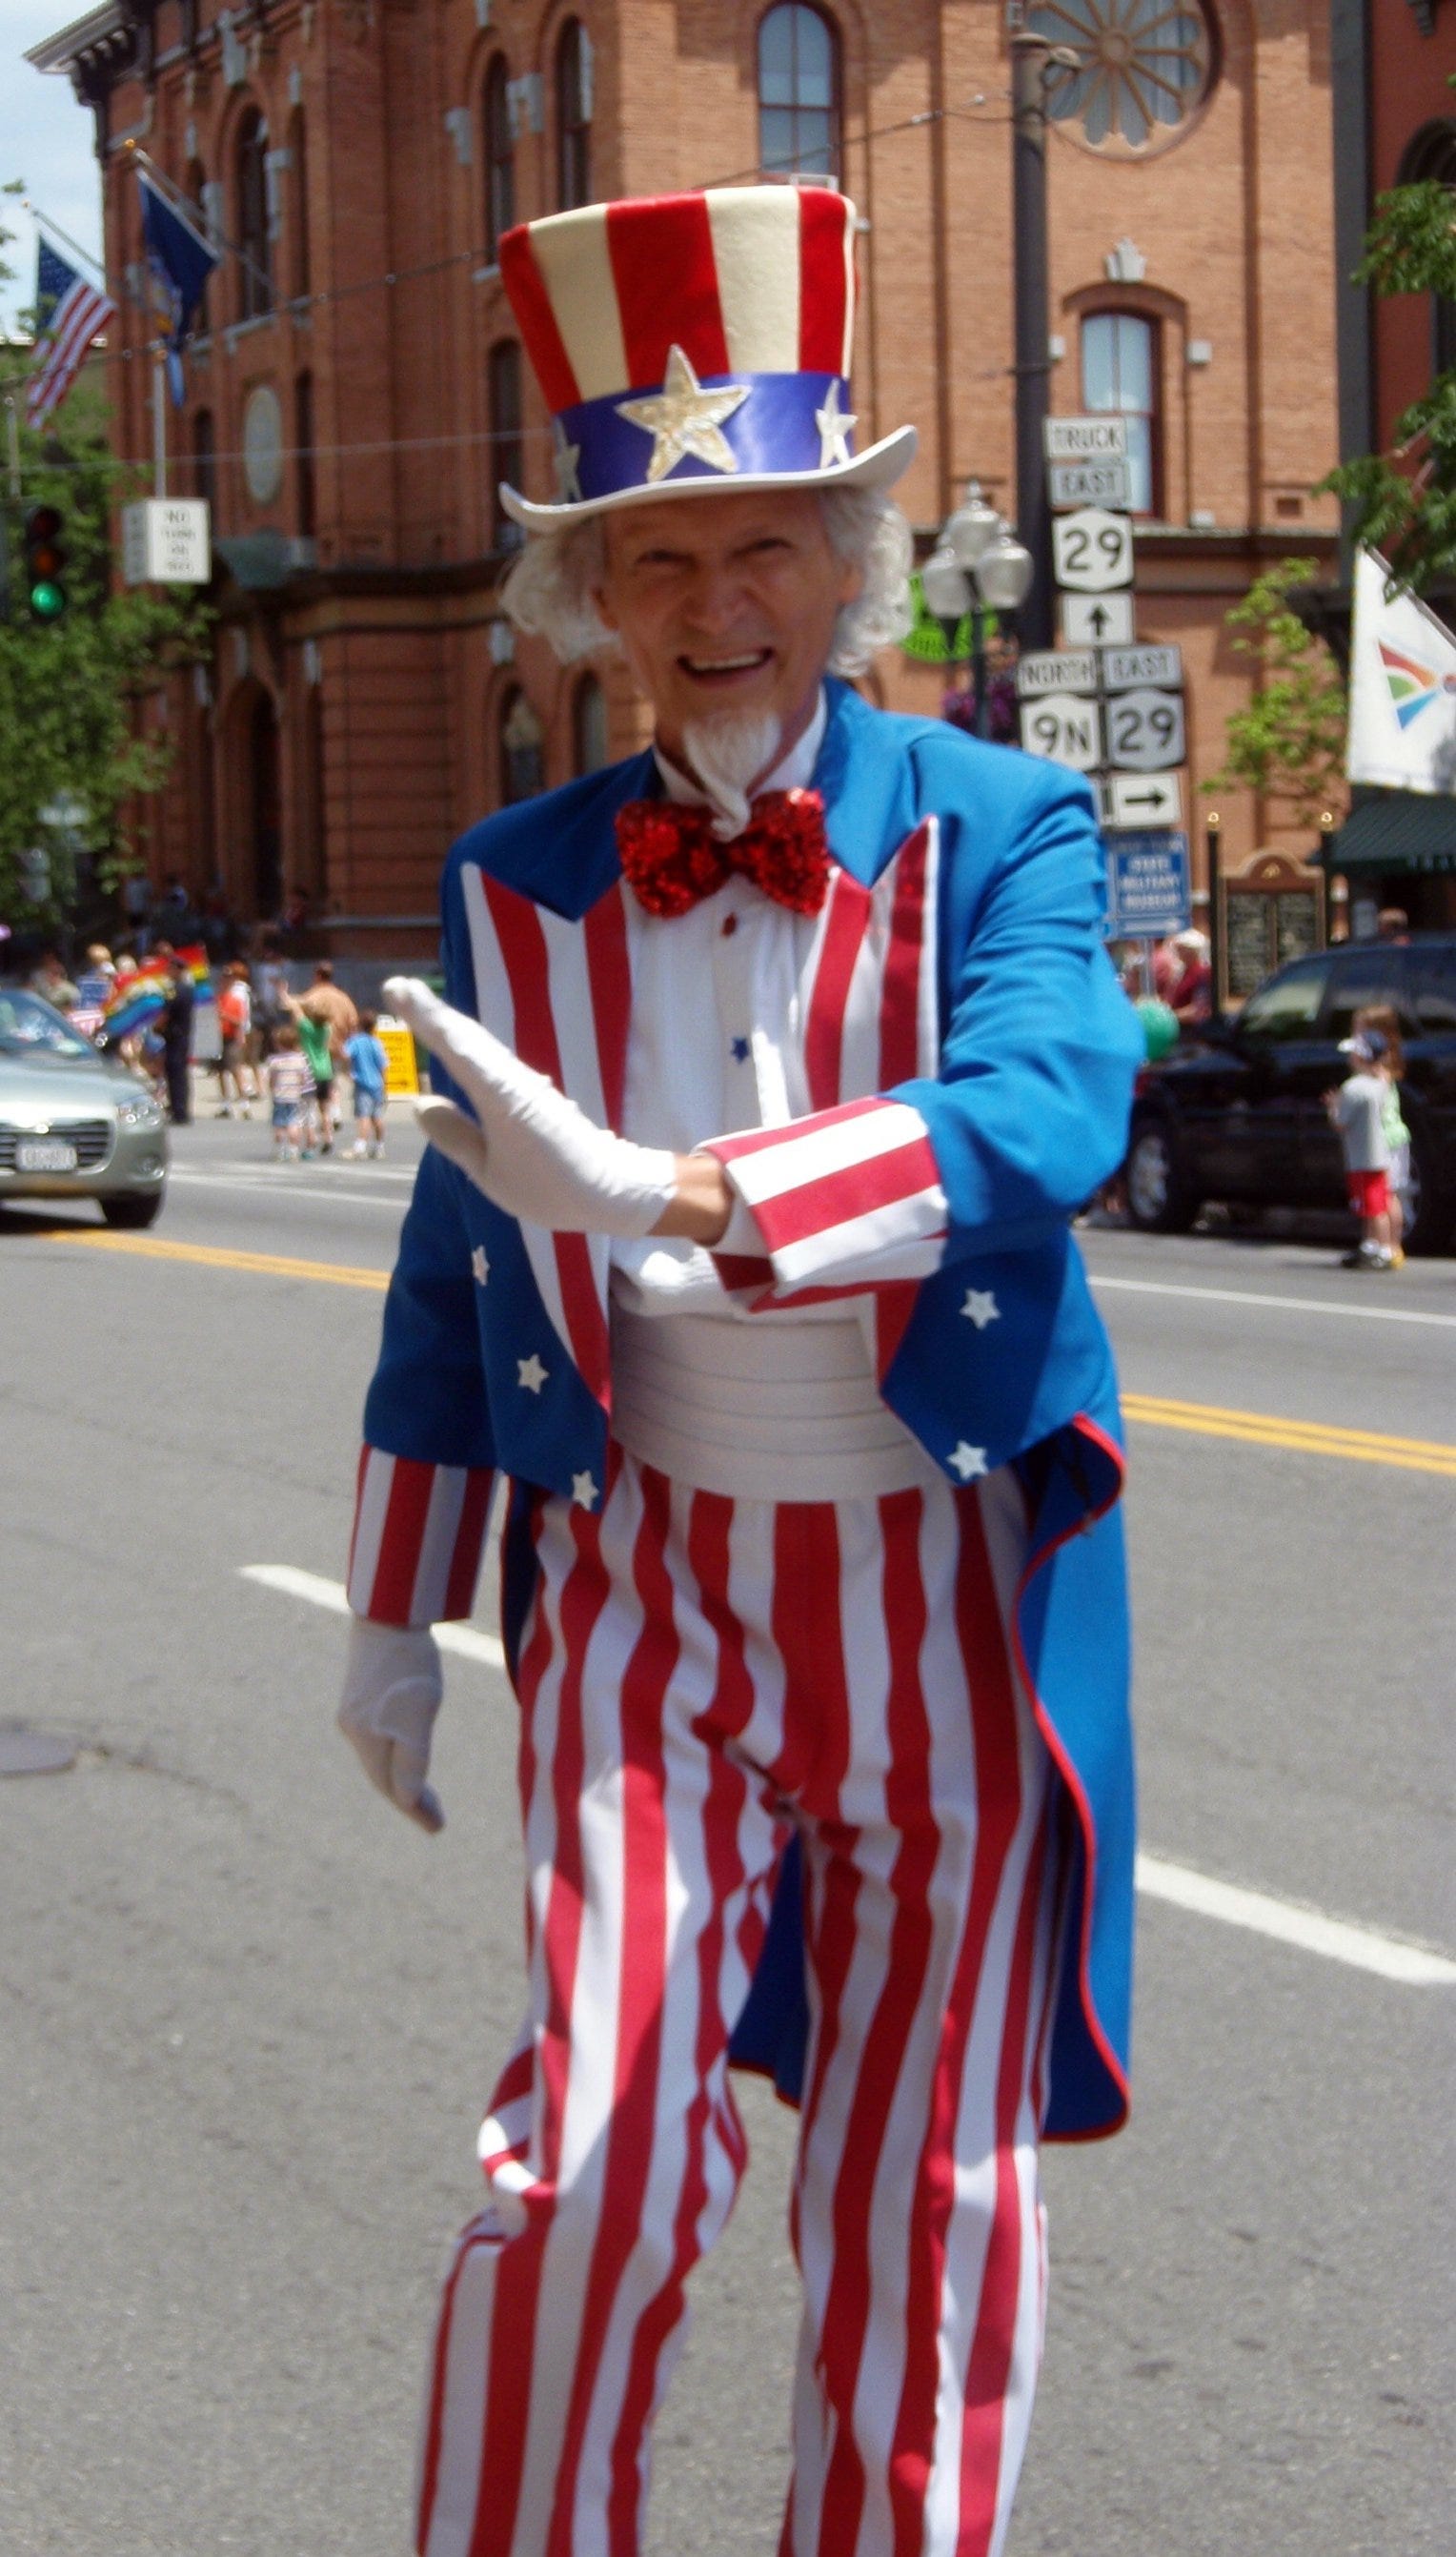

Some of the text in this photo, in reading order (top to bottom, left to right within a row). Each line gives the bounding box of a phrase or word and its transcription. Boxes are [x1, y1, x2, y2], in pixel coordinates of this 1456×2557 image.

[1054, 425, 1122, 449] TRUCK
[1062, 470, 1116, 493] EAST
[1064, 530, 1123, 570] 29
[1026, 658, 1095, 684] NORTH
[1113, 652, 1169, 678] EAST
[1034, 713, 1090, 754] 9N
[1118, 707, 1175, 753] 29
